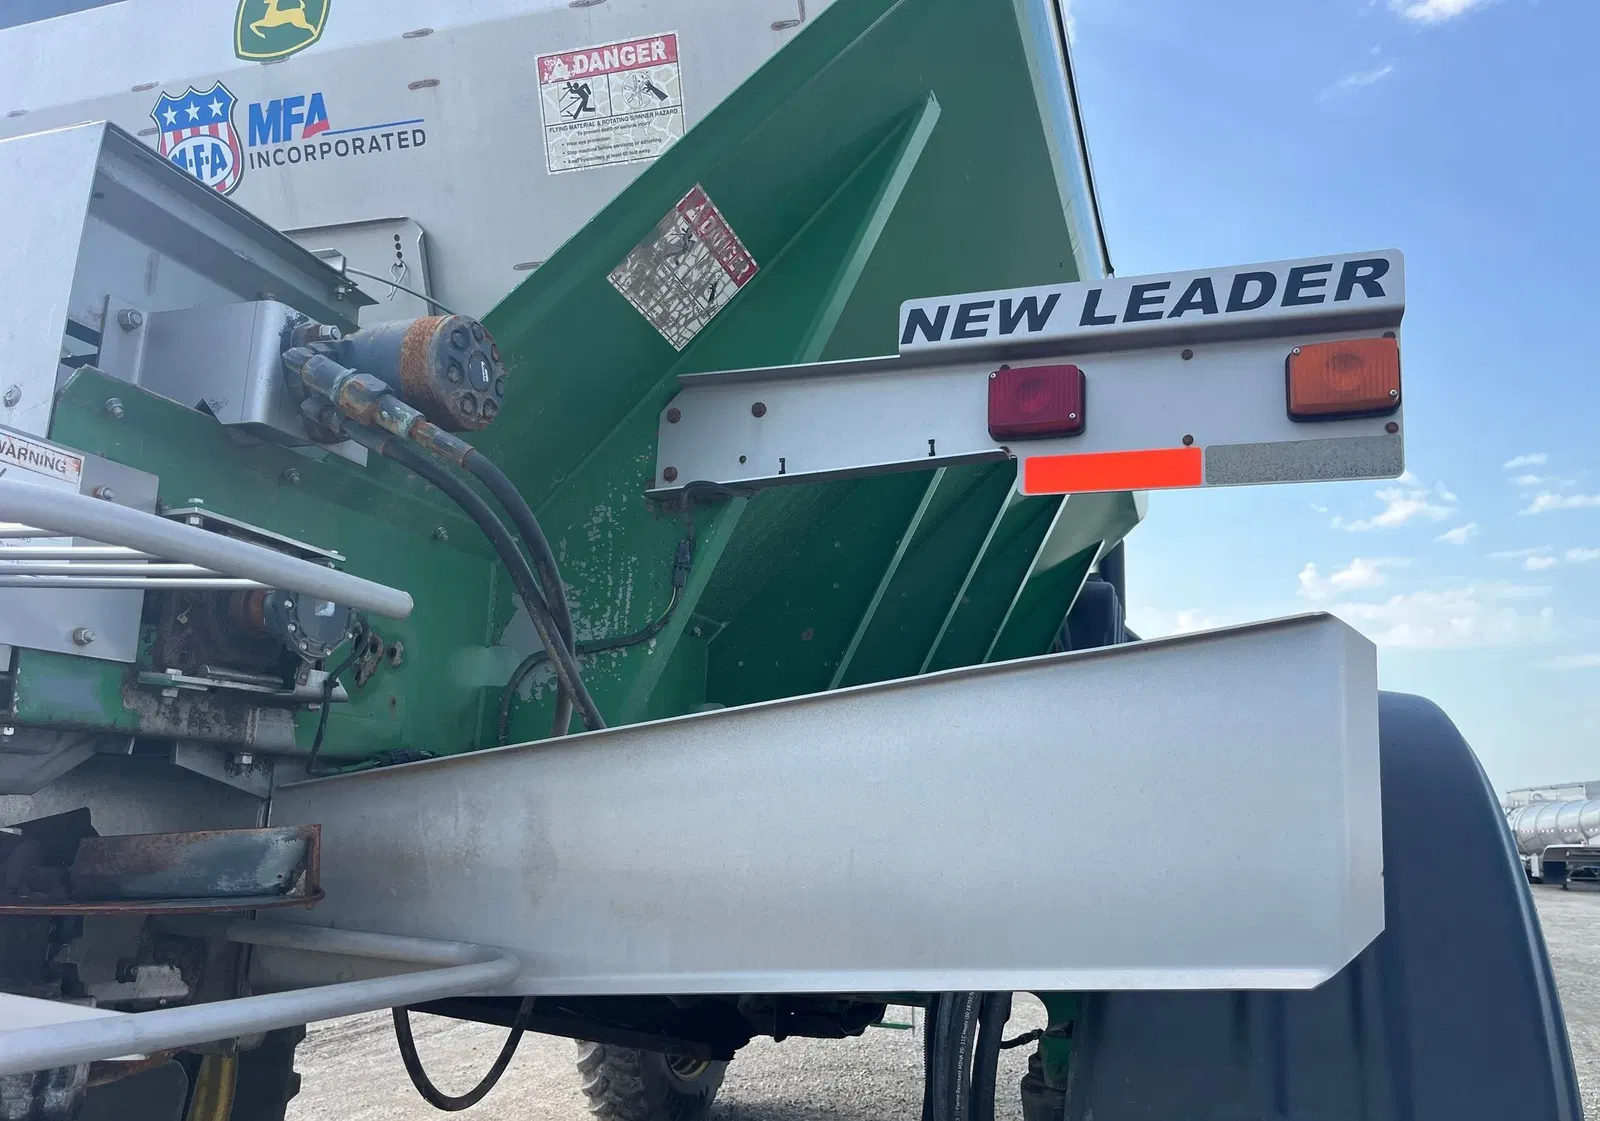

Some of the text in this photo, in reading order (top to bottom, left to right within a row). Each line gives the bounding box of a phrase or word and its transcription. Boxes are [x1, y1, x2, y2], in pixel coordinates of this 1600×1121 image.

[573, 39, 667, 74] DANGER
[249, 92, 330, 147] MFA
[549, 125, 568, 133] FLYING
[569, 121, 596, 131] MATERIAL
[602, 115, 629, 125] ROTATING
[630, 111, 654, 121] SPINNER
[250, 129, 427, 169] INCORPORATED
[900, 258, 1391, 345] NEW LEADER
